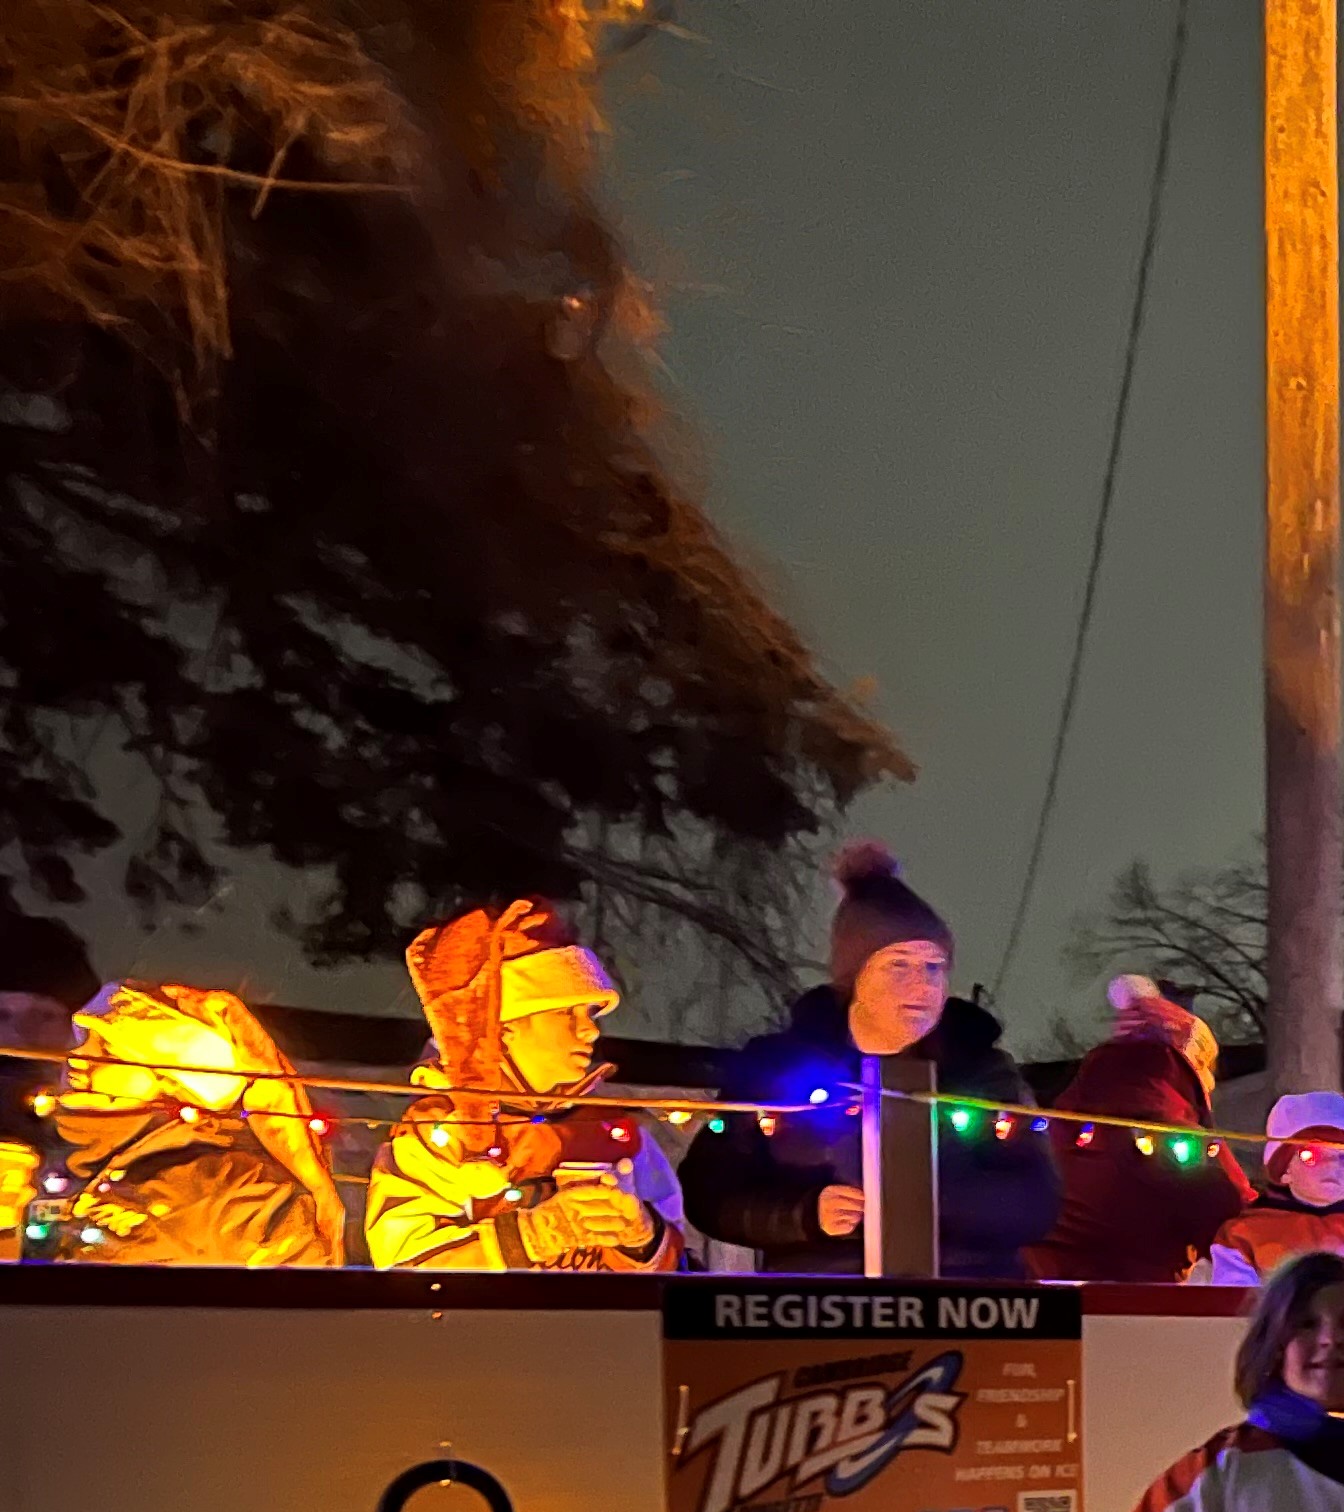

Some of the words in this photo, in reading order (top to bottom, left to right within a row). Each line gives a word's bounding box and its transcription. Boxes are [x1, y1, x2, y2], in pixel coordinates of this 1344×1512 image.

[714, 1294, 924, 1329] REGISTER
[937, 1297, 1040, 1329] NOW
[1027, 1463, 1052, 1479] ON
[1054, 1462, 1080, 1478] ICE
